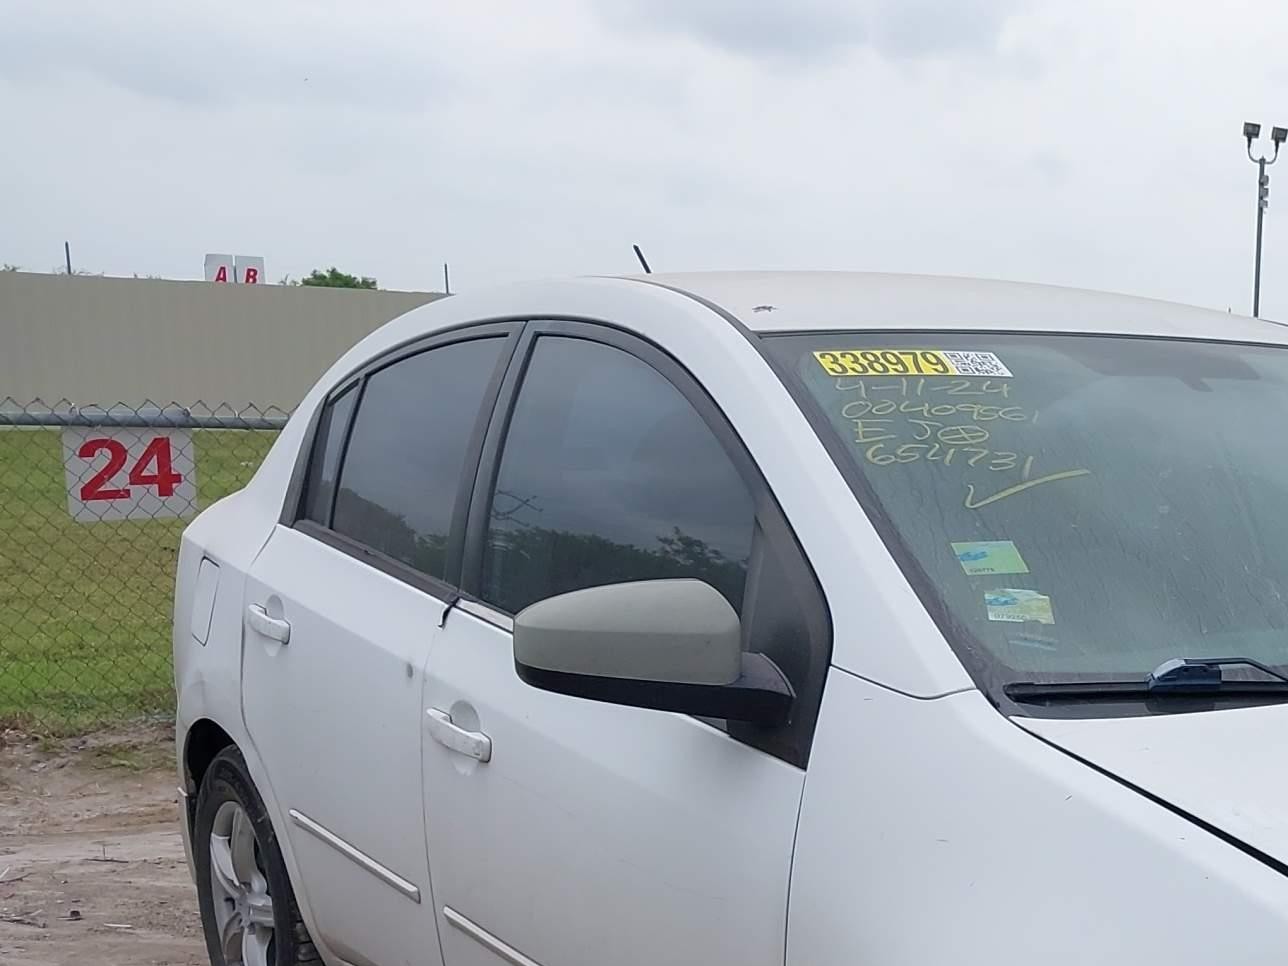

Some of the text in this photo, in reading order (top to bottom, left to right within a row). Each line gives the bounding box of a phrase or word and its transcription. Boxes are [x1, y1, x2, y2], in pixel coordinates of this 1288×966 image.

[214, 265, 228, 283] A
[244, 267, 258, 284] B
[818, 351, 951, 375] 338979
[78, 436, 183, 501] 24
